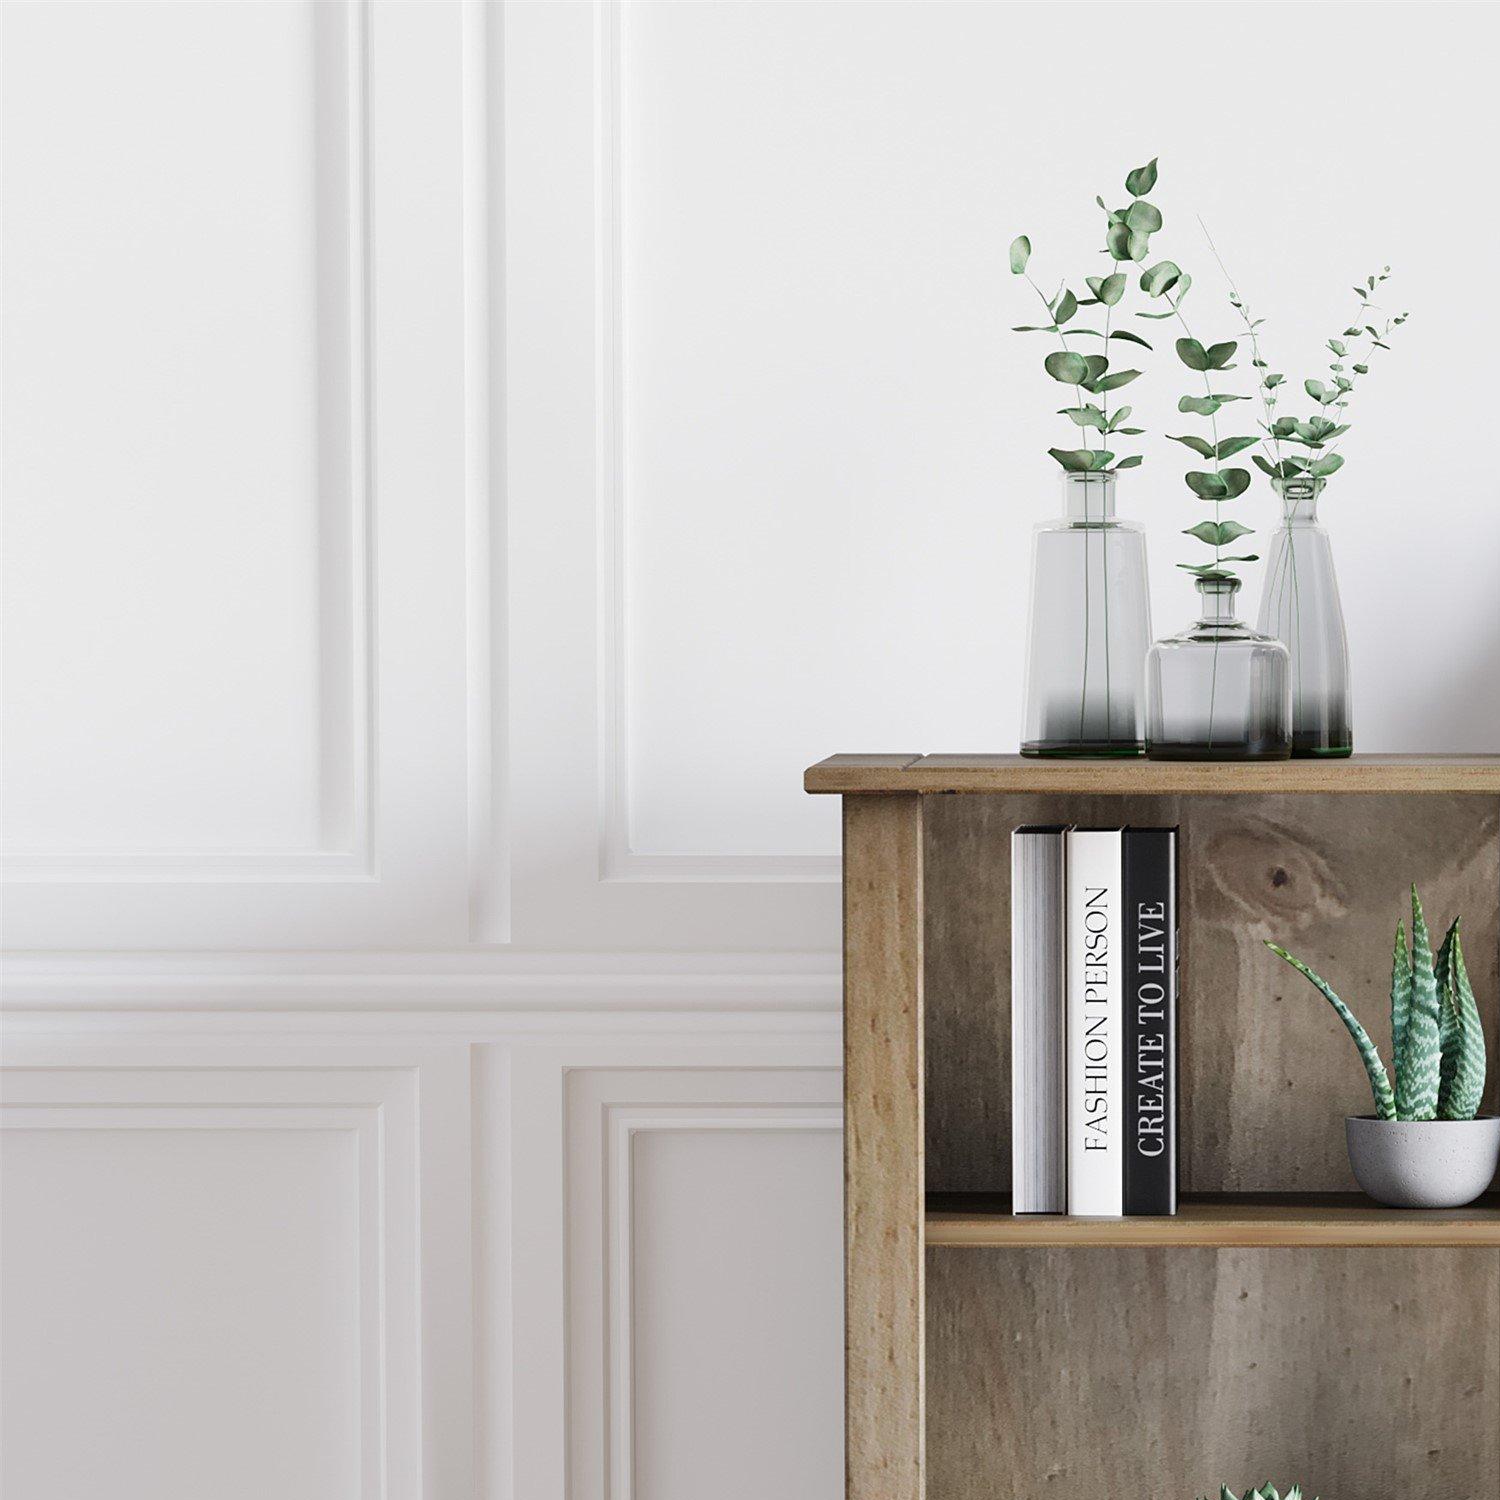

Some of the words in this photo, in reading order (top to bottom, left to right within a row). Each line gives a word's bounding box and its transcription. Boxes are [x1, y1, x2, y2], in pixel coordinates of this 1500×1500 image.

[1084, 886, 1108, 1003] PERSON
[1138, 900, 1165, 973] LIVE
[1136, 981, 1165, 1025] TO
[1084, 1016, 1108, 1152] FASHION
[1136, 1033, 1165, 1158] CREATE
